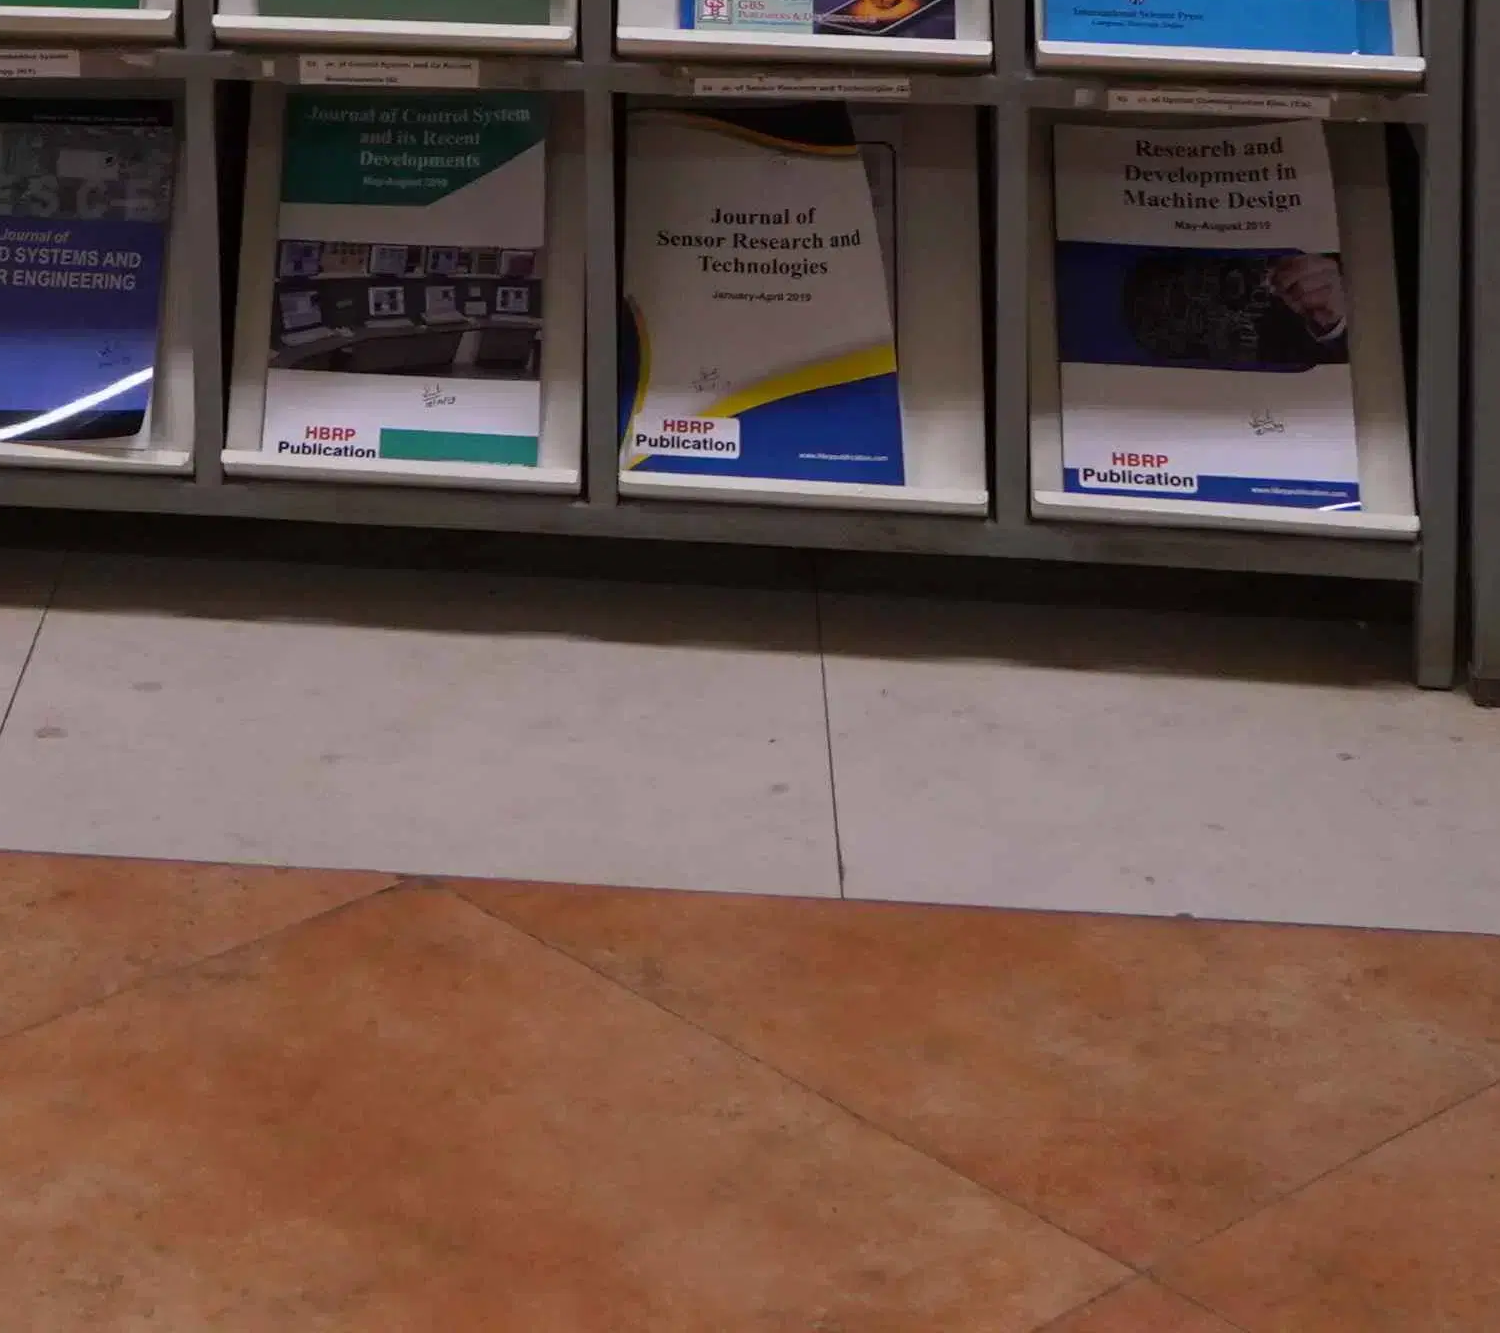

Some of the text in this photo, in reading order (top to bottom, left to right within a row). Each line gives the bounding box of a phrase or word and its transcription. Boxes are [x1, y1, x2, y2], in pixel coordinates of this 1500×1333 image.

[1134, 135, 1285, 159] Research and
[358, 150, 482, 170] Developments
[1123, 161, 1299, 189] Development in
[1122, 188, 1303, 214] Machine Design
[710, 207, 818, 227] Journal of
[0, 227, 53, 244] Journal
[54, 229, 72, 245] of
[655, 228, 862, 252] Sensor Research and
[13, 245, 102, 268] SYSTEMS
[101, 249, 142, 270] AND
[696, 253, 829, 279] Technologies
[11, 267, 138, 293] ENGINEERING
[304, 424, 357, 442] HBRP
[661, 418, 715, 434] HBRP
[276, 440, 378, 460] Publication
[634, 433, 738, 454] Publication
[1111, 451, 1169, 469] HBRP
[1081, 467, 1195, 490] Publication
